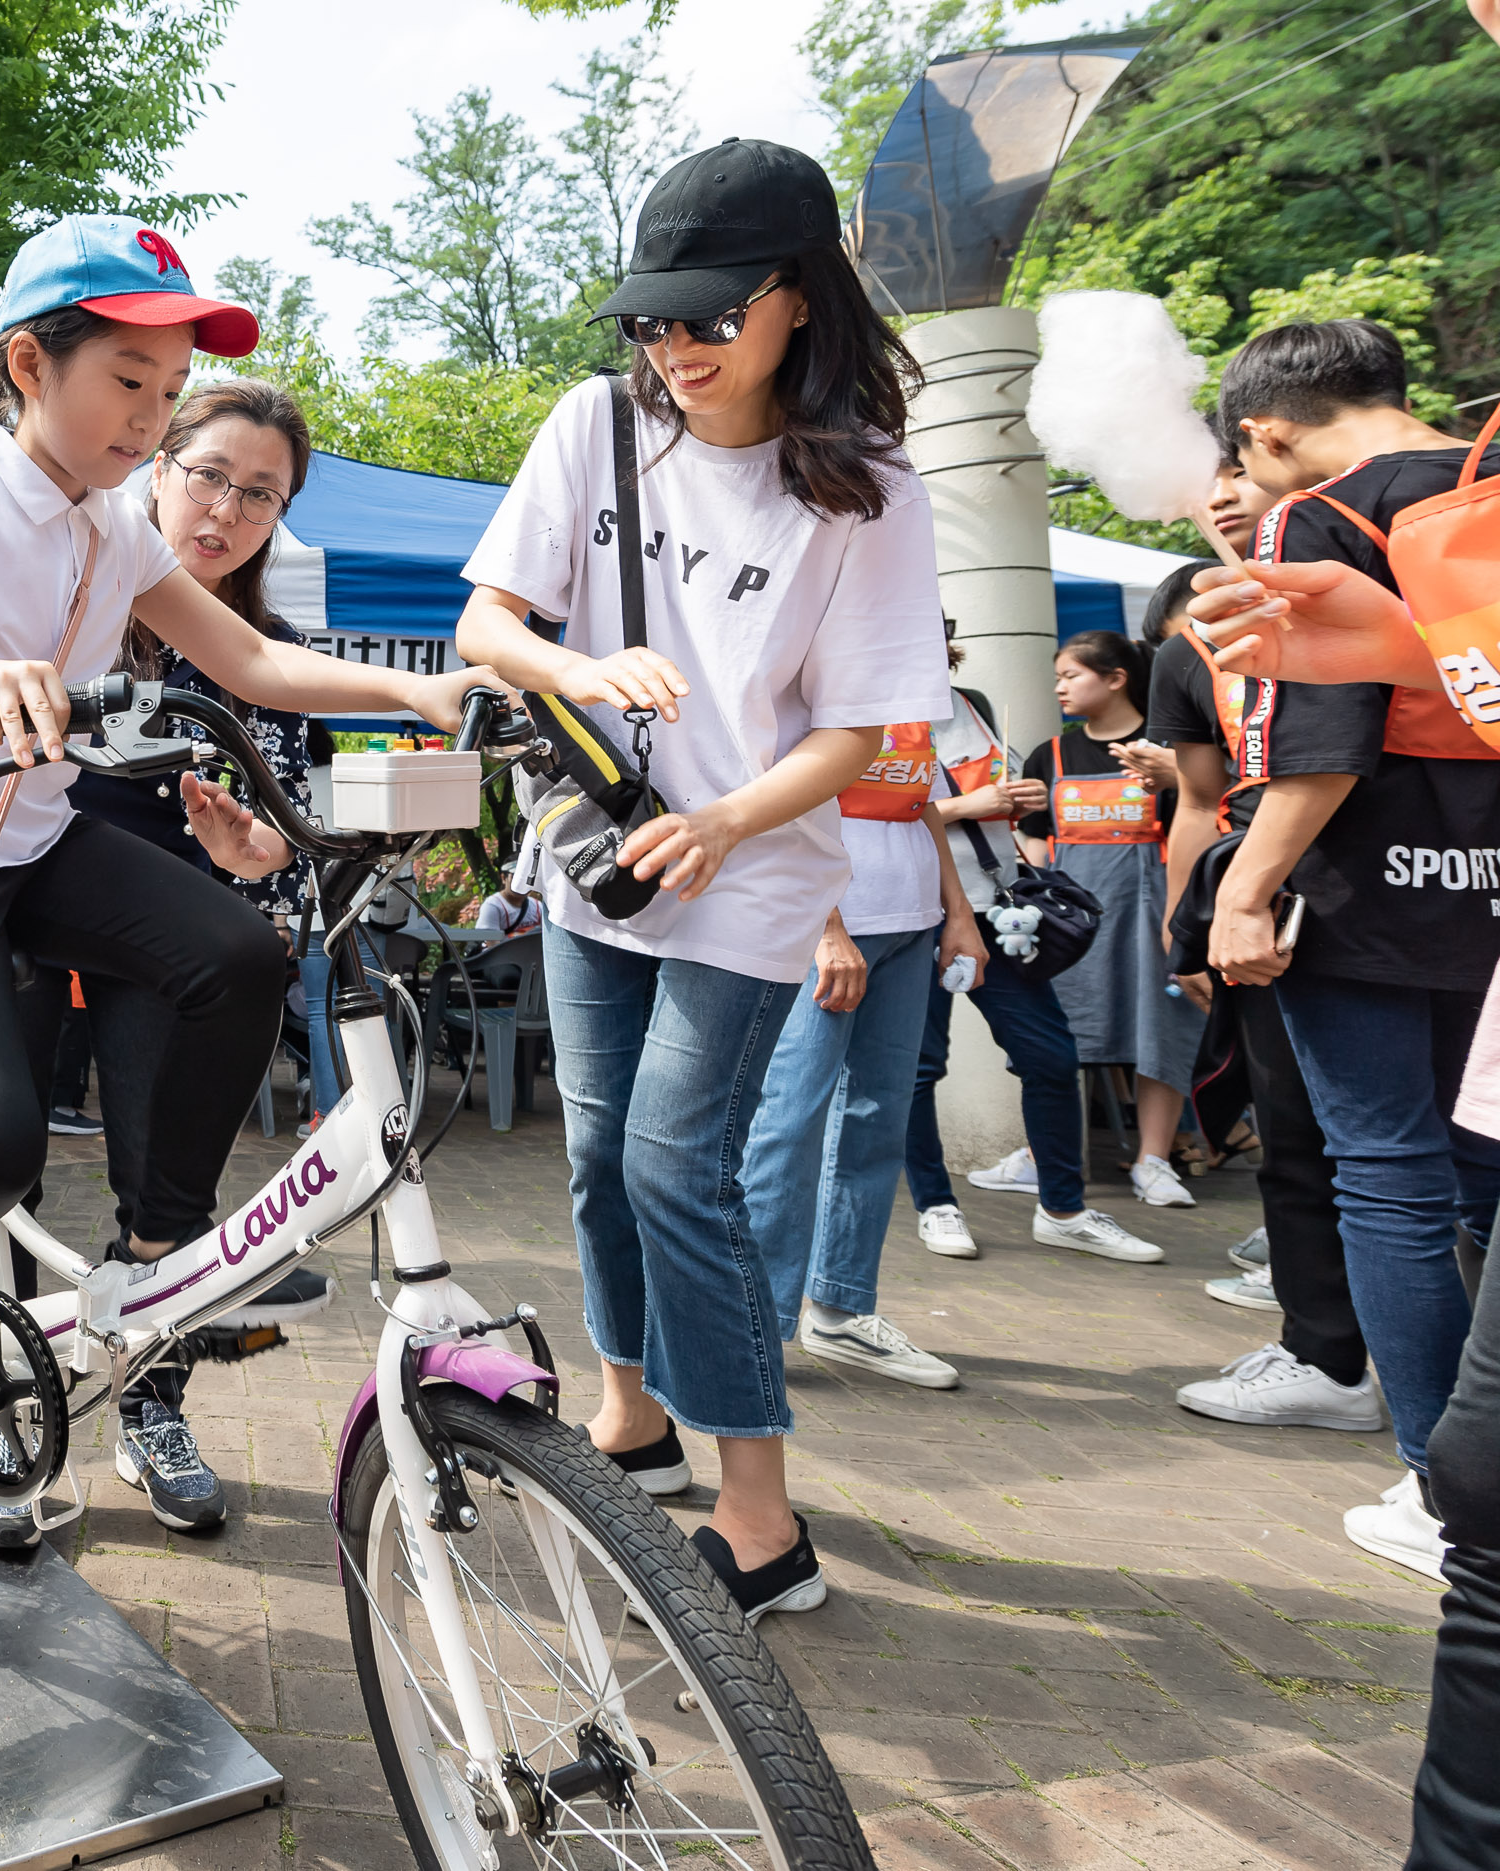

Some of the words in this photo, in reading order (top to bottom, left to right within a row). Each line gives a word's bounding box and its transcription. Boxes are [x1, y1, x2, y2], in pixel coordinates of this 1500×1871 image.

[1258, 500, 1293, 556] PORTS
[1248, 677, 1274, 726] PORTS
[1062, 804, 1145, 823] 환경사랑
[219, 1149, 338, 1266] Lavia
